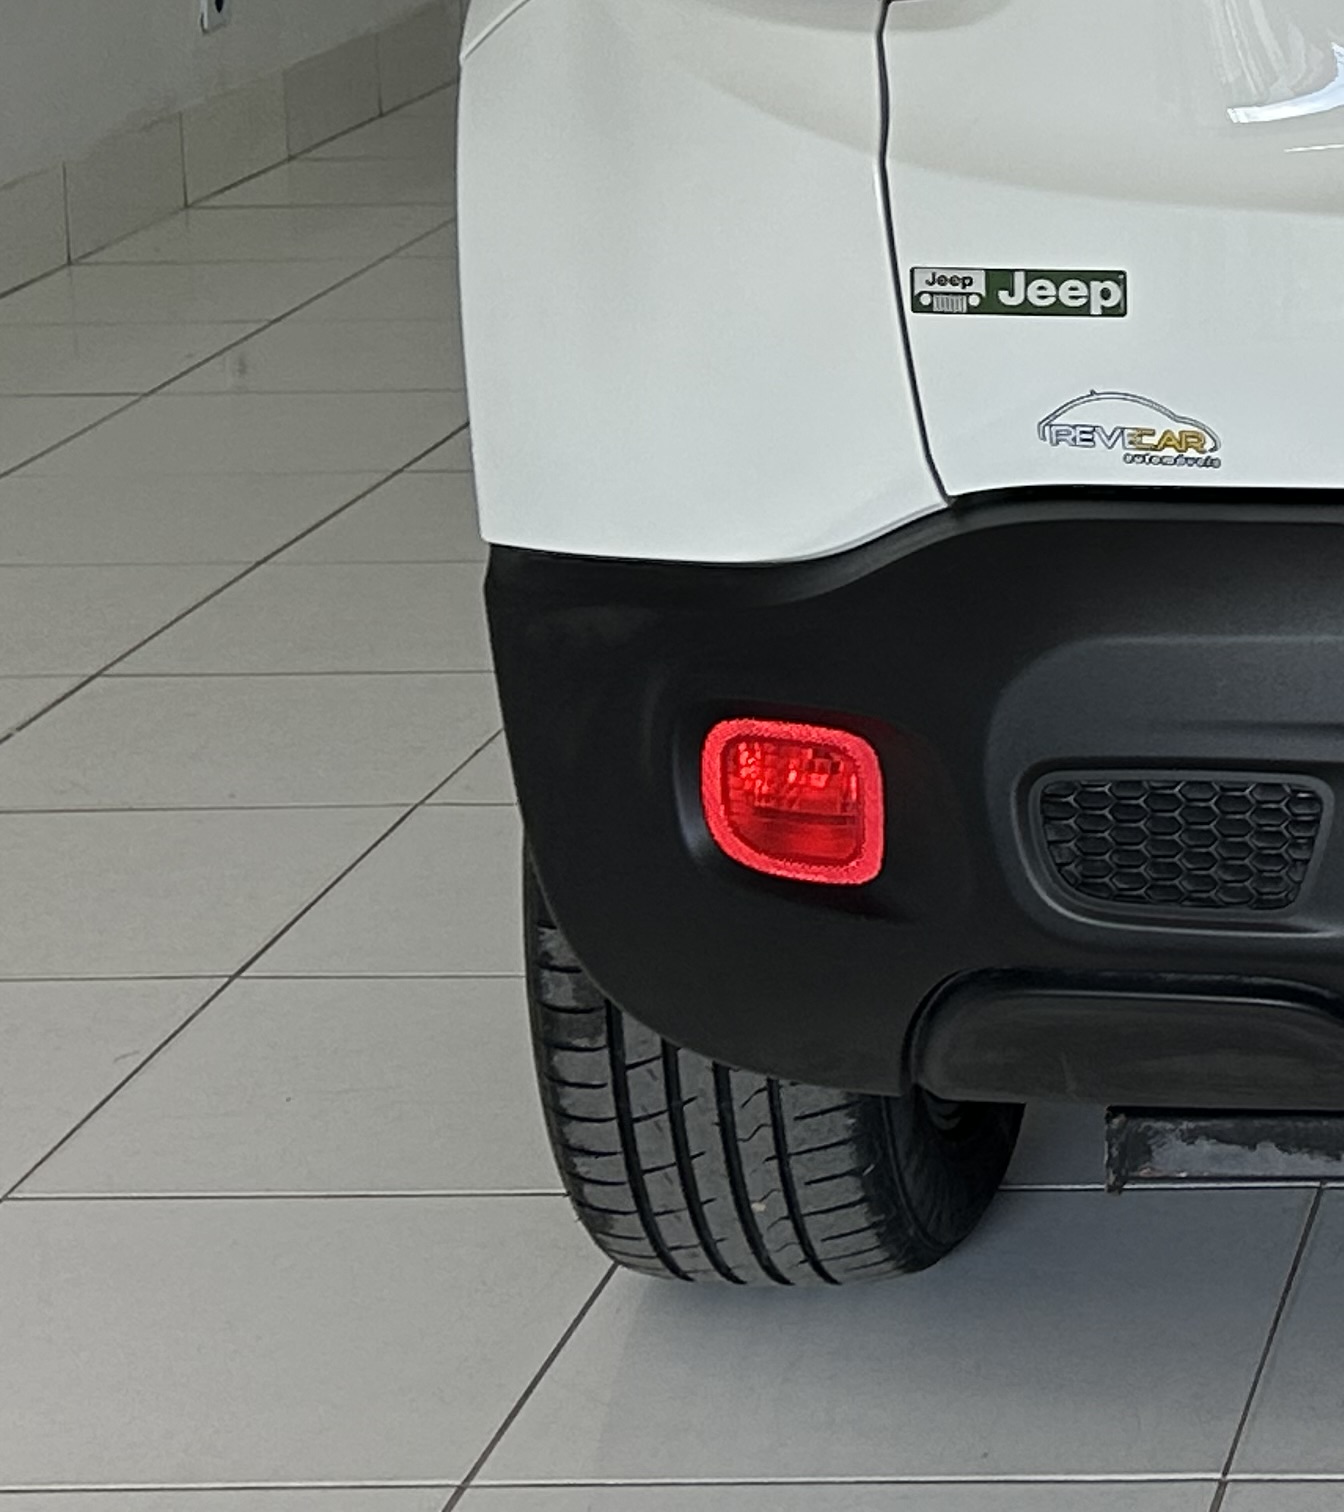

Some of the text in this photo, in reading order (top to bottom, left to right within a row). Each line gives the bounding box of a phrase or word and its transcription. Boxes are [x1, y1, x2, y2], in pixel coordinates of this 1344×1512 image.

[925, 271, 974, 289] Jeep
[998, 270, 1123, 316] Jeep
[1049, 424, 1208, 454] REVECAR
